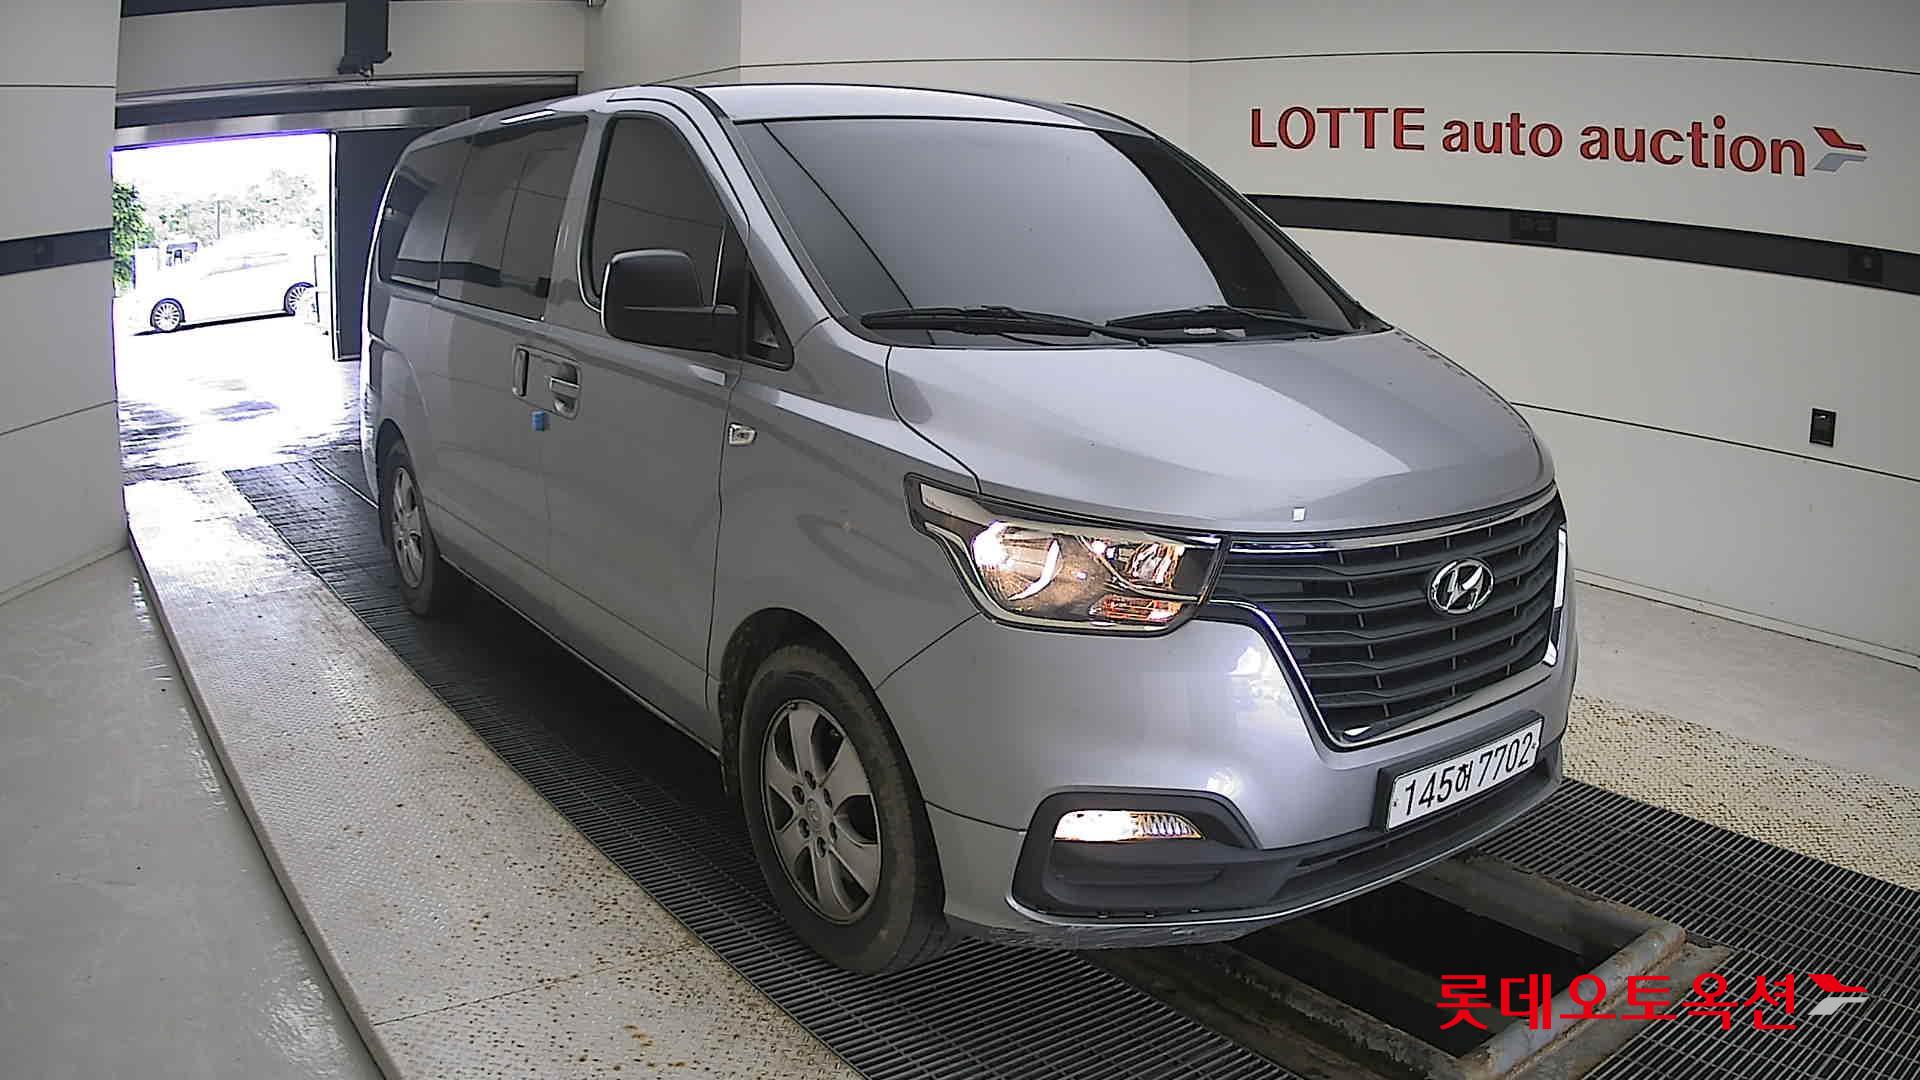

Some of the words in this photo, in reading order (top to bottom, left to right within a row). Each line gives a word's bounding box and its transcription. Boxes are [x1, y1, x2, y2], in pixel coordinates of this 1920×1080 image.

[1250, 106, 1425, 151] LOTTE
[1442, 112, 1563, 158] auto
[1580, 115, 1807, 177] auction
[1405, 760, 1474, 816] 145허
[1478, 731, 1533, 788] 7702
